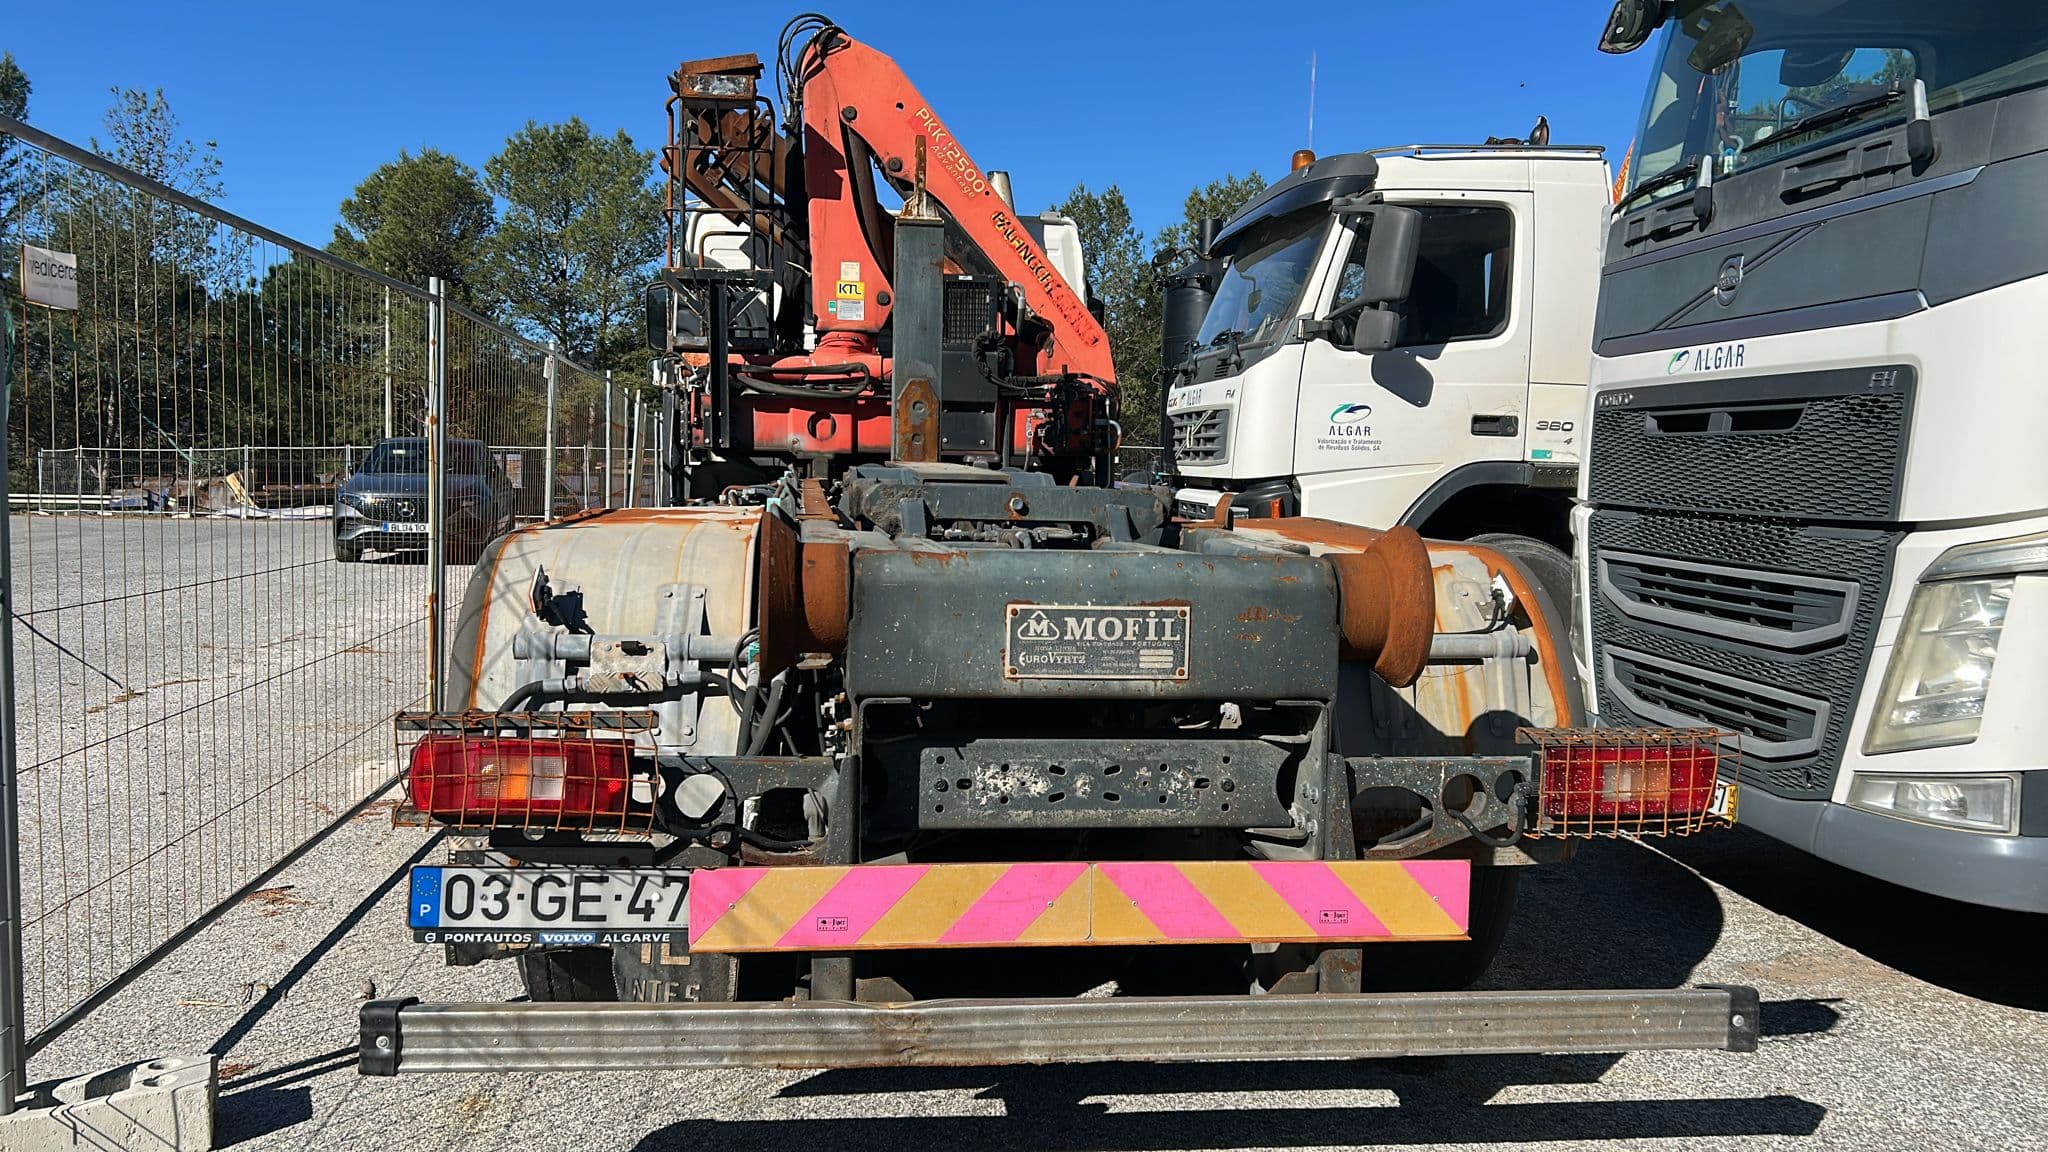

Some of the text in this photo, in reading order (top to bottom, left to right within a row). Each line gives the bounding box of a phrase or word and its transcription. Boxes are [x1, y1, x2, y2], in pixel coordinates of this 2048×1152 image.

[915, 107, 946, 143] PKK
[839, 283, 862, 295] KTL
[1694, 344, 1745, 371] ALGAR
[1868, 370, 1897, 388] FH
[1329, 425, 1371, 437] ALGAR
[419, 905, 432, 917] P
[444, 933, 670, 943] PONTAUTOS VOLVO ALGARVE
